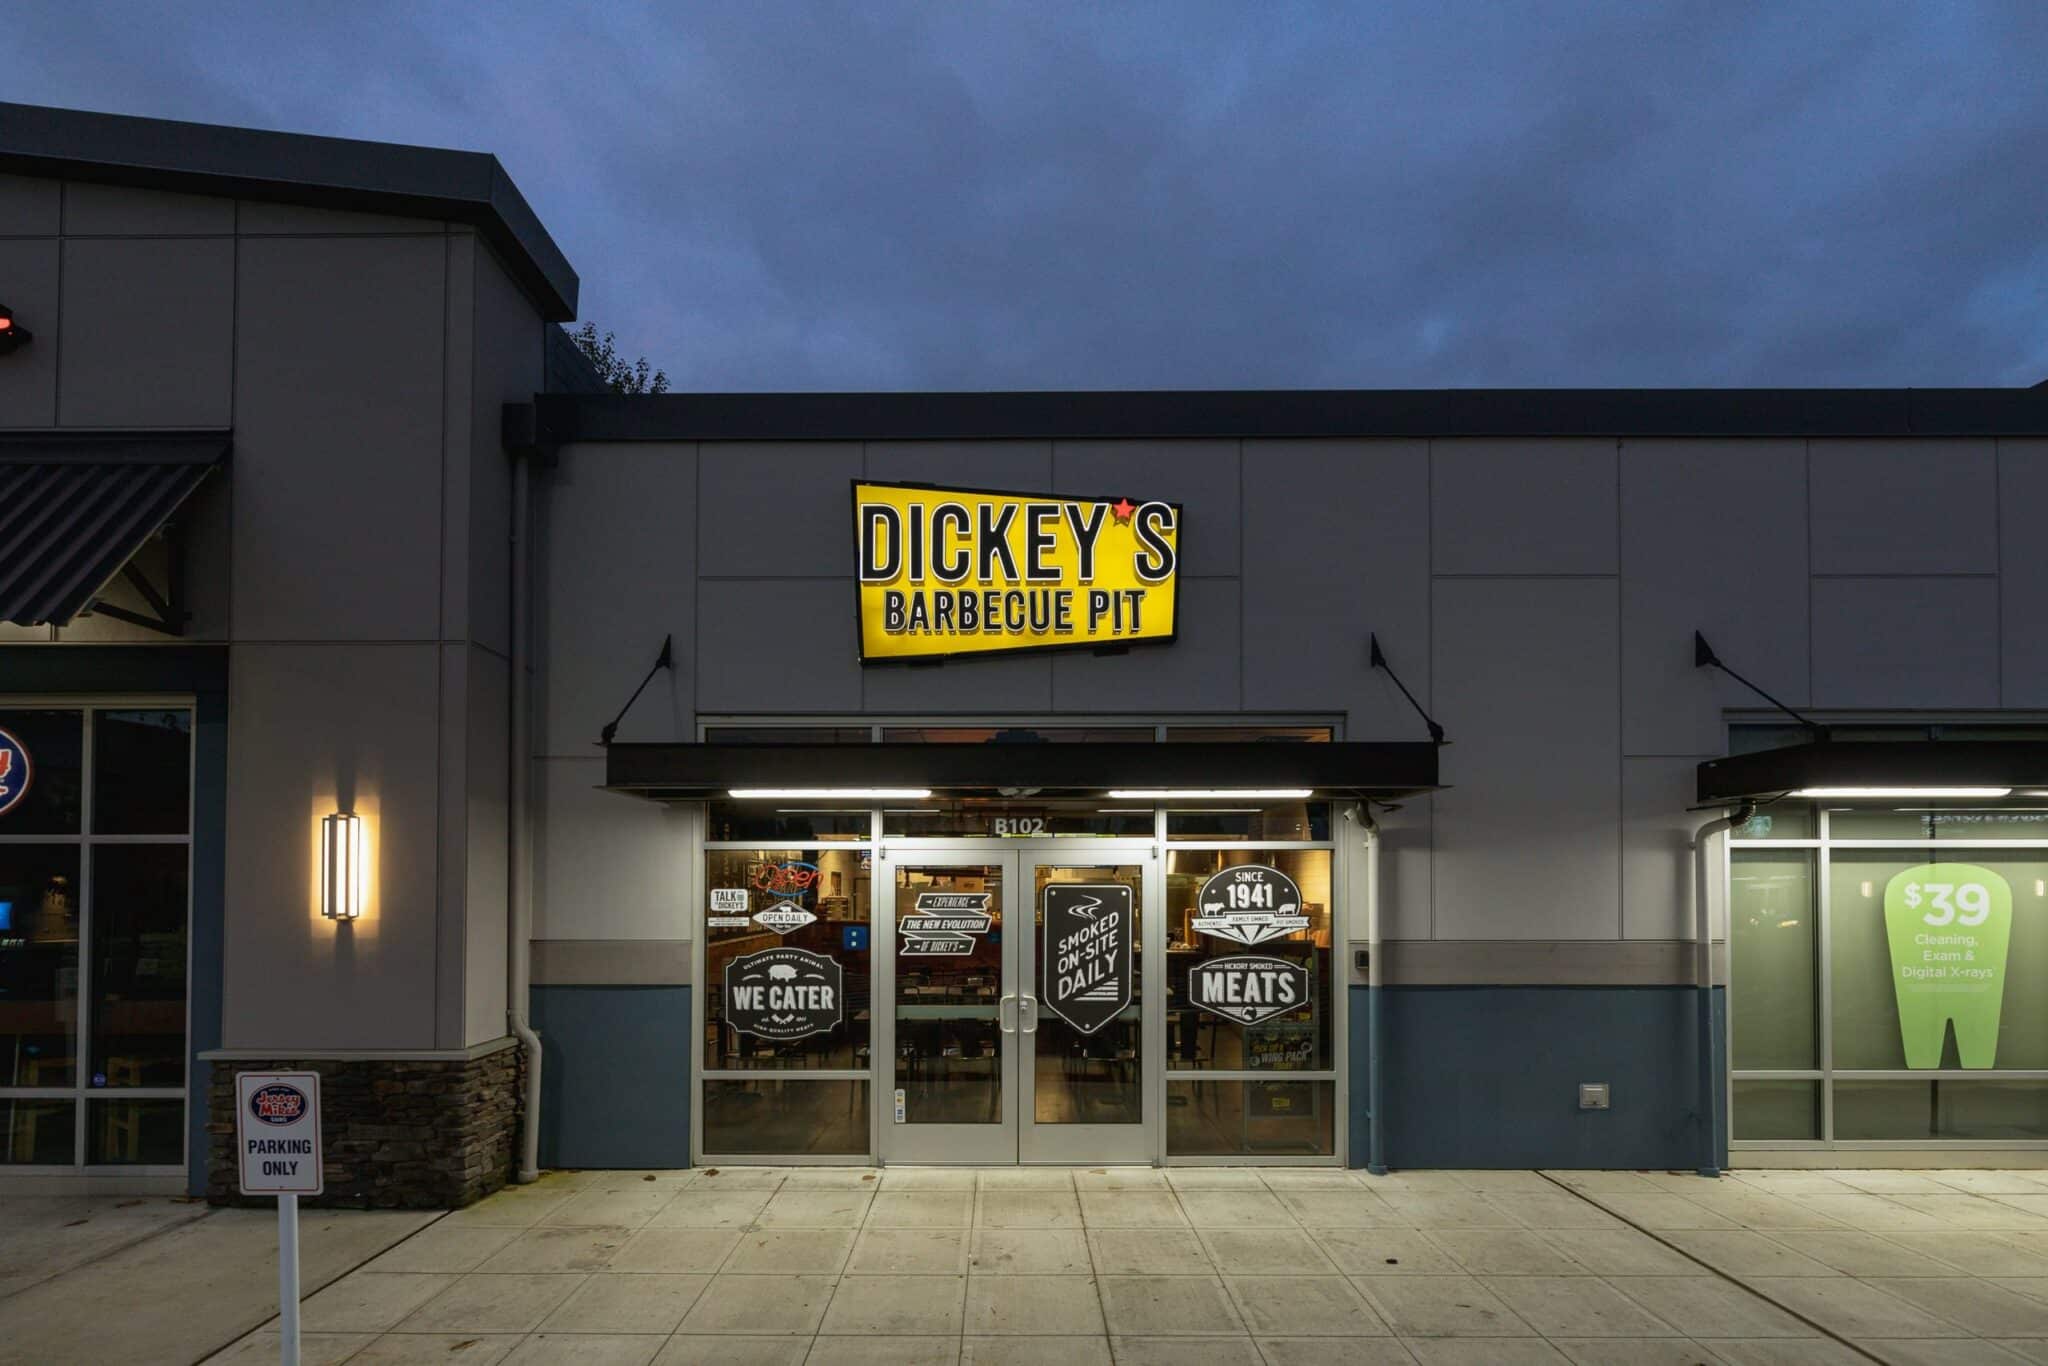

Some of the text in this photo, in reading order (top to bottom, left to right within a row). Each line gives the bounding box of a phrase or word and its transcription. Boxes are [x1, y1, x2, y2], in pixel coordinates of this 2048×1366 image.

[883, 590, 1147, 633] BARBECUE PIT
[995, 818, 1044, 834] B102
[1235, 872, 1264, 882] SINCE
[715, 890, 737, 901] TALK
[932, 897, 969, 908] EXPERIENCE
[1226, 883, 1273, 908] 1941
[1904, 882, 1990, 926] $39
[906, 919, 986, 929] THE NEW EVOLUTION
[1058, 912, 1119, 955] SMOKED
[1914, 933, 1978, 948] Cleaning,
[920, 942, 930, 952] OF
[1058, 929, 1118, 974] ON-SITE
[1922, 950, 1974, 960] Exam &
[743, 954, 774, 970] ULTIMATE
[800, 956, 824, 970] ANIMAL
[1059, 949, 1118, 1001] DAILY
[1902, 966, 1993, 979] Digital X-rays
[1202, 971, 1295, 1004] MEATS
[733, 986, 834, 1010] WE CATER
[248, 1139, 312, 1154] PARKING
[262, 1160, 298, 1176] ONLY
